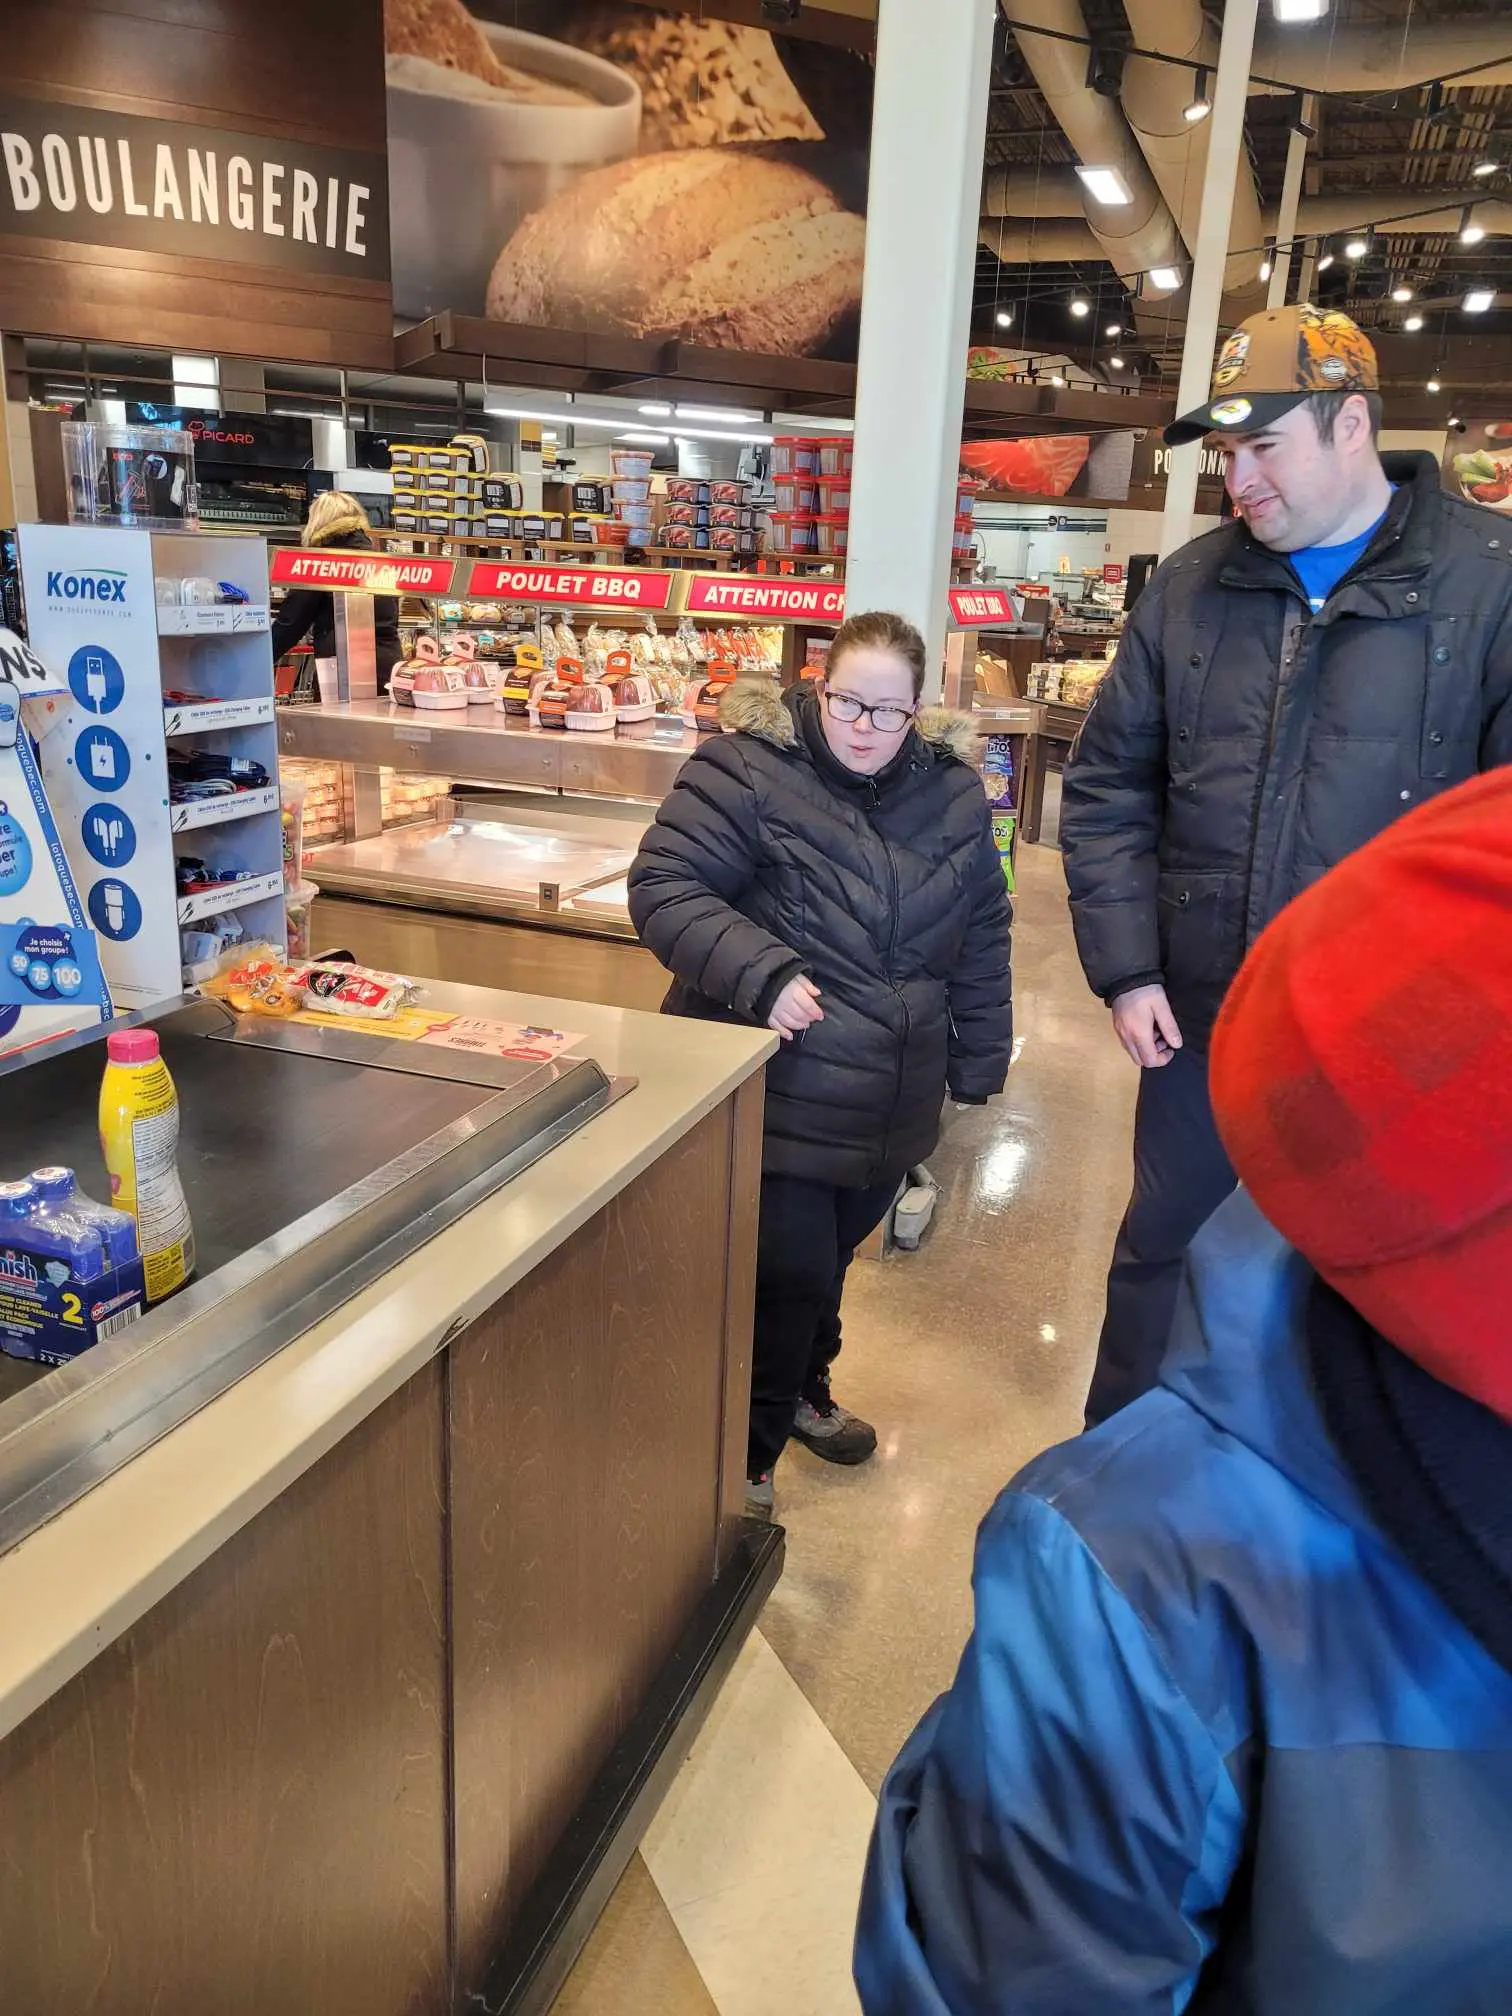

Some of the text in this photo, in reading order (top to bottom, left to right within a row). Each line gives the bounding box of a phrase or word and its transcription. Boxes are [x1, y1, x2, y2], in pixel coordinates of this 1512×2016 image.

[1, 132, 370, 257] BOULANGERIE
[202, 430, 254, 444] PICARD
[291, 558, 432, 585] ATTENTION CHAUD
[47, 571, 126, 602] Konex
[495, 572, 642, 599] POULET BBQ
[703, 585, 818, 611] ATTENTION
[956, 596, 988, 616] POULET
[29, 937, 63, 947] Je choisis
[12, 954, 27, 968] 50
[32, 967, 49, 981] 75
[54, 967, 82, 985] 100
[62, 1292, 84, 1325] 2
